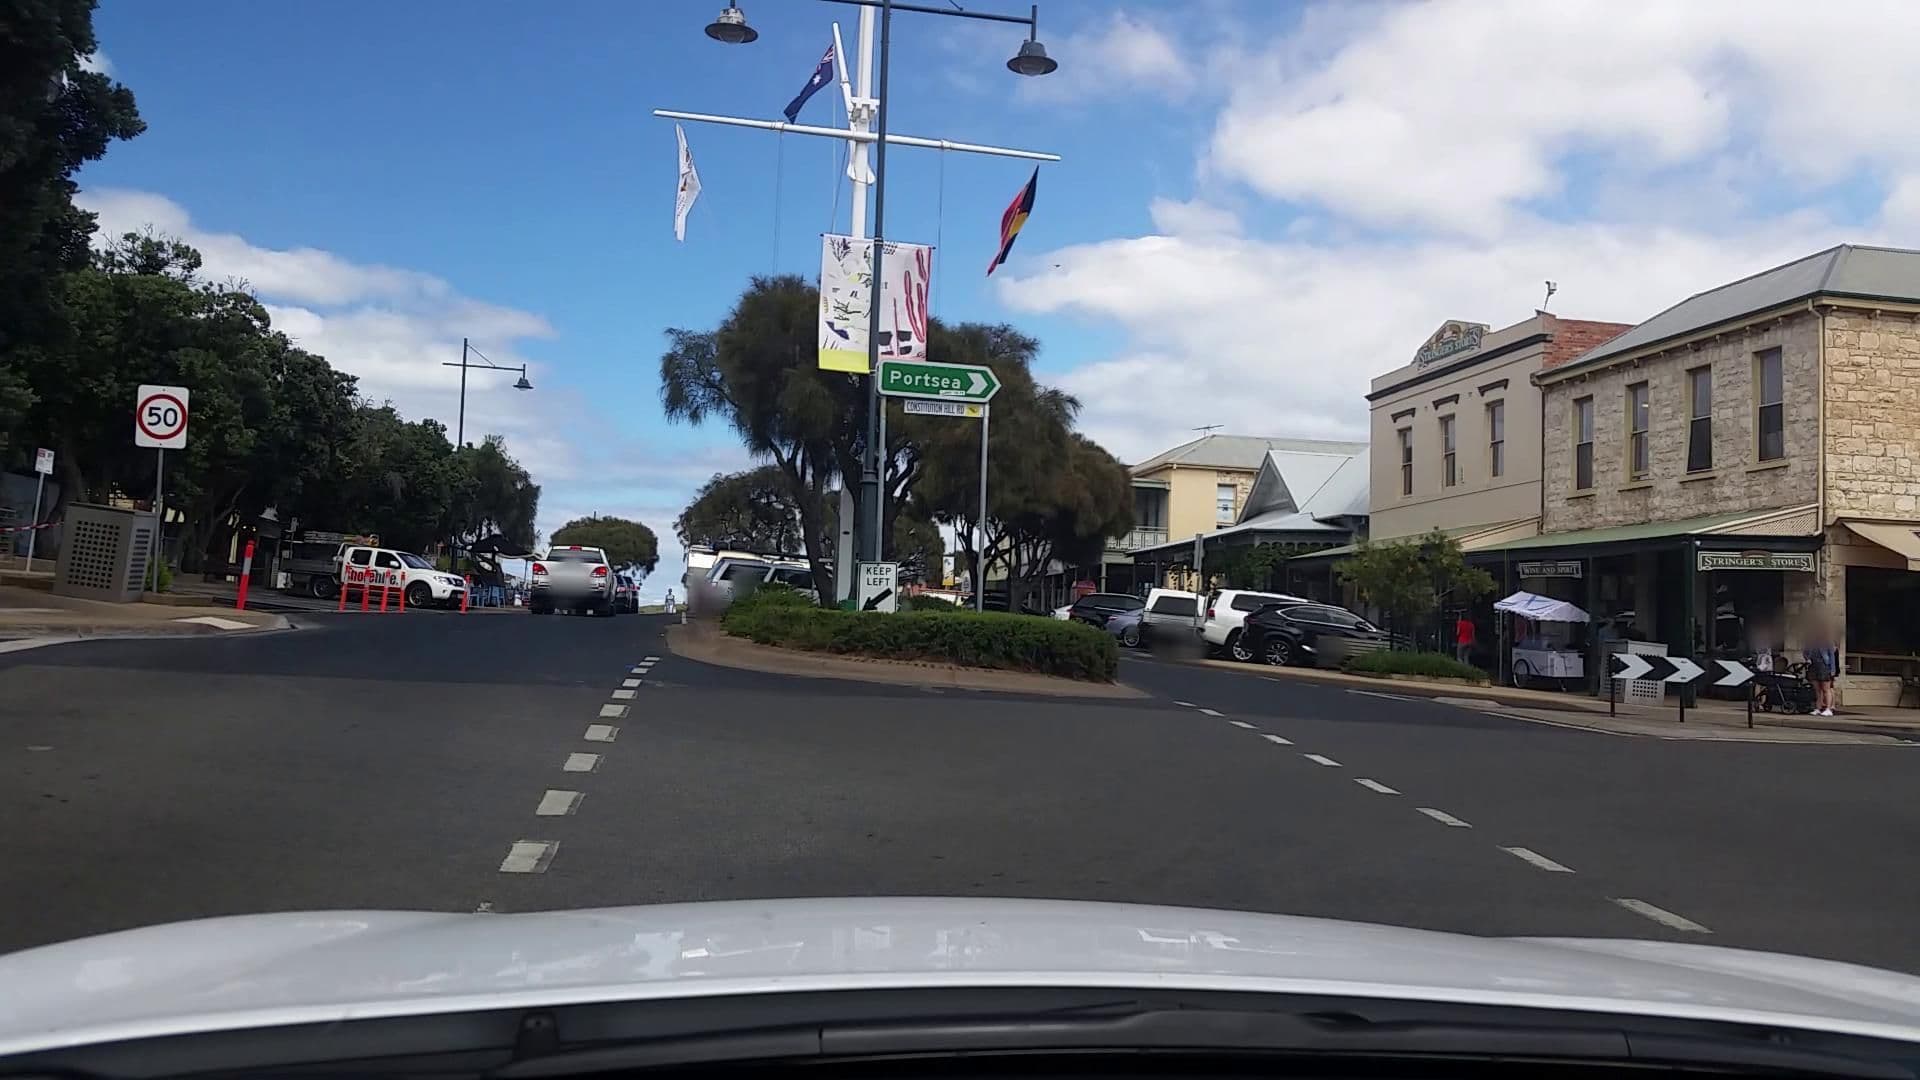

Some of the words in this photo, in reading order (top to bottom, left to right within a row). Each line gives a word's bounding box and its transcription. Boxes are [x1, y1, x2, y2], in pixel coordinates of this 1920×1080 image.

[890, 370, 961, 389] Portsea
[906, 401, 943, 413] CONSTITUTION
[944, 403, 956, 414] HILL
[957, 405, 965, 415] RD
[147, 406, 178, 427] 50
[1771, 558, 1808, 567] STORES
[866, 566, 892, 576] KEEP
[866, 577, 890, 586] LEFT
